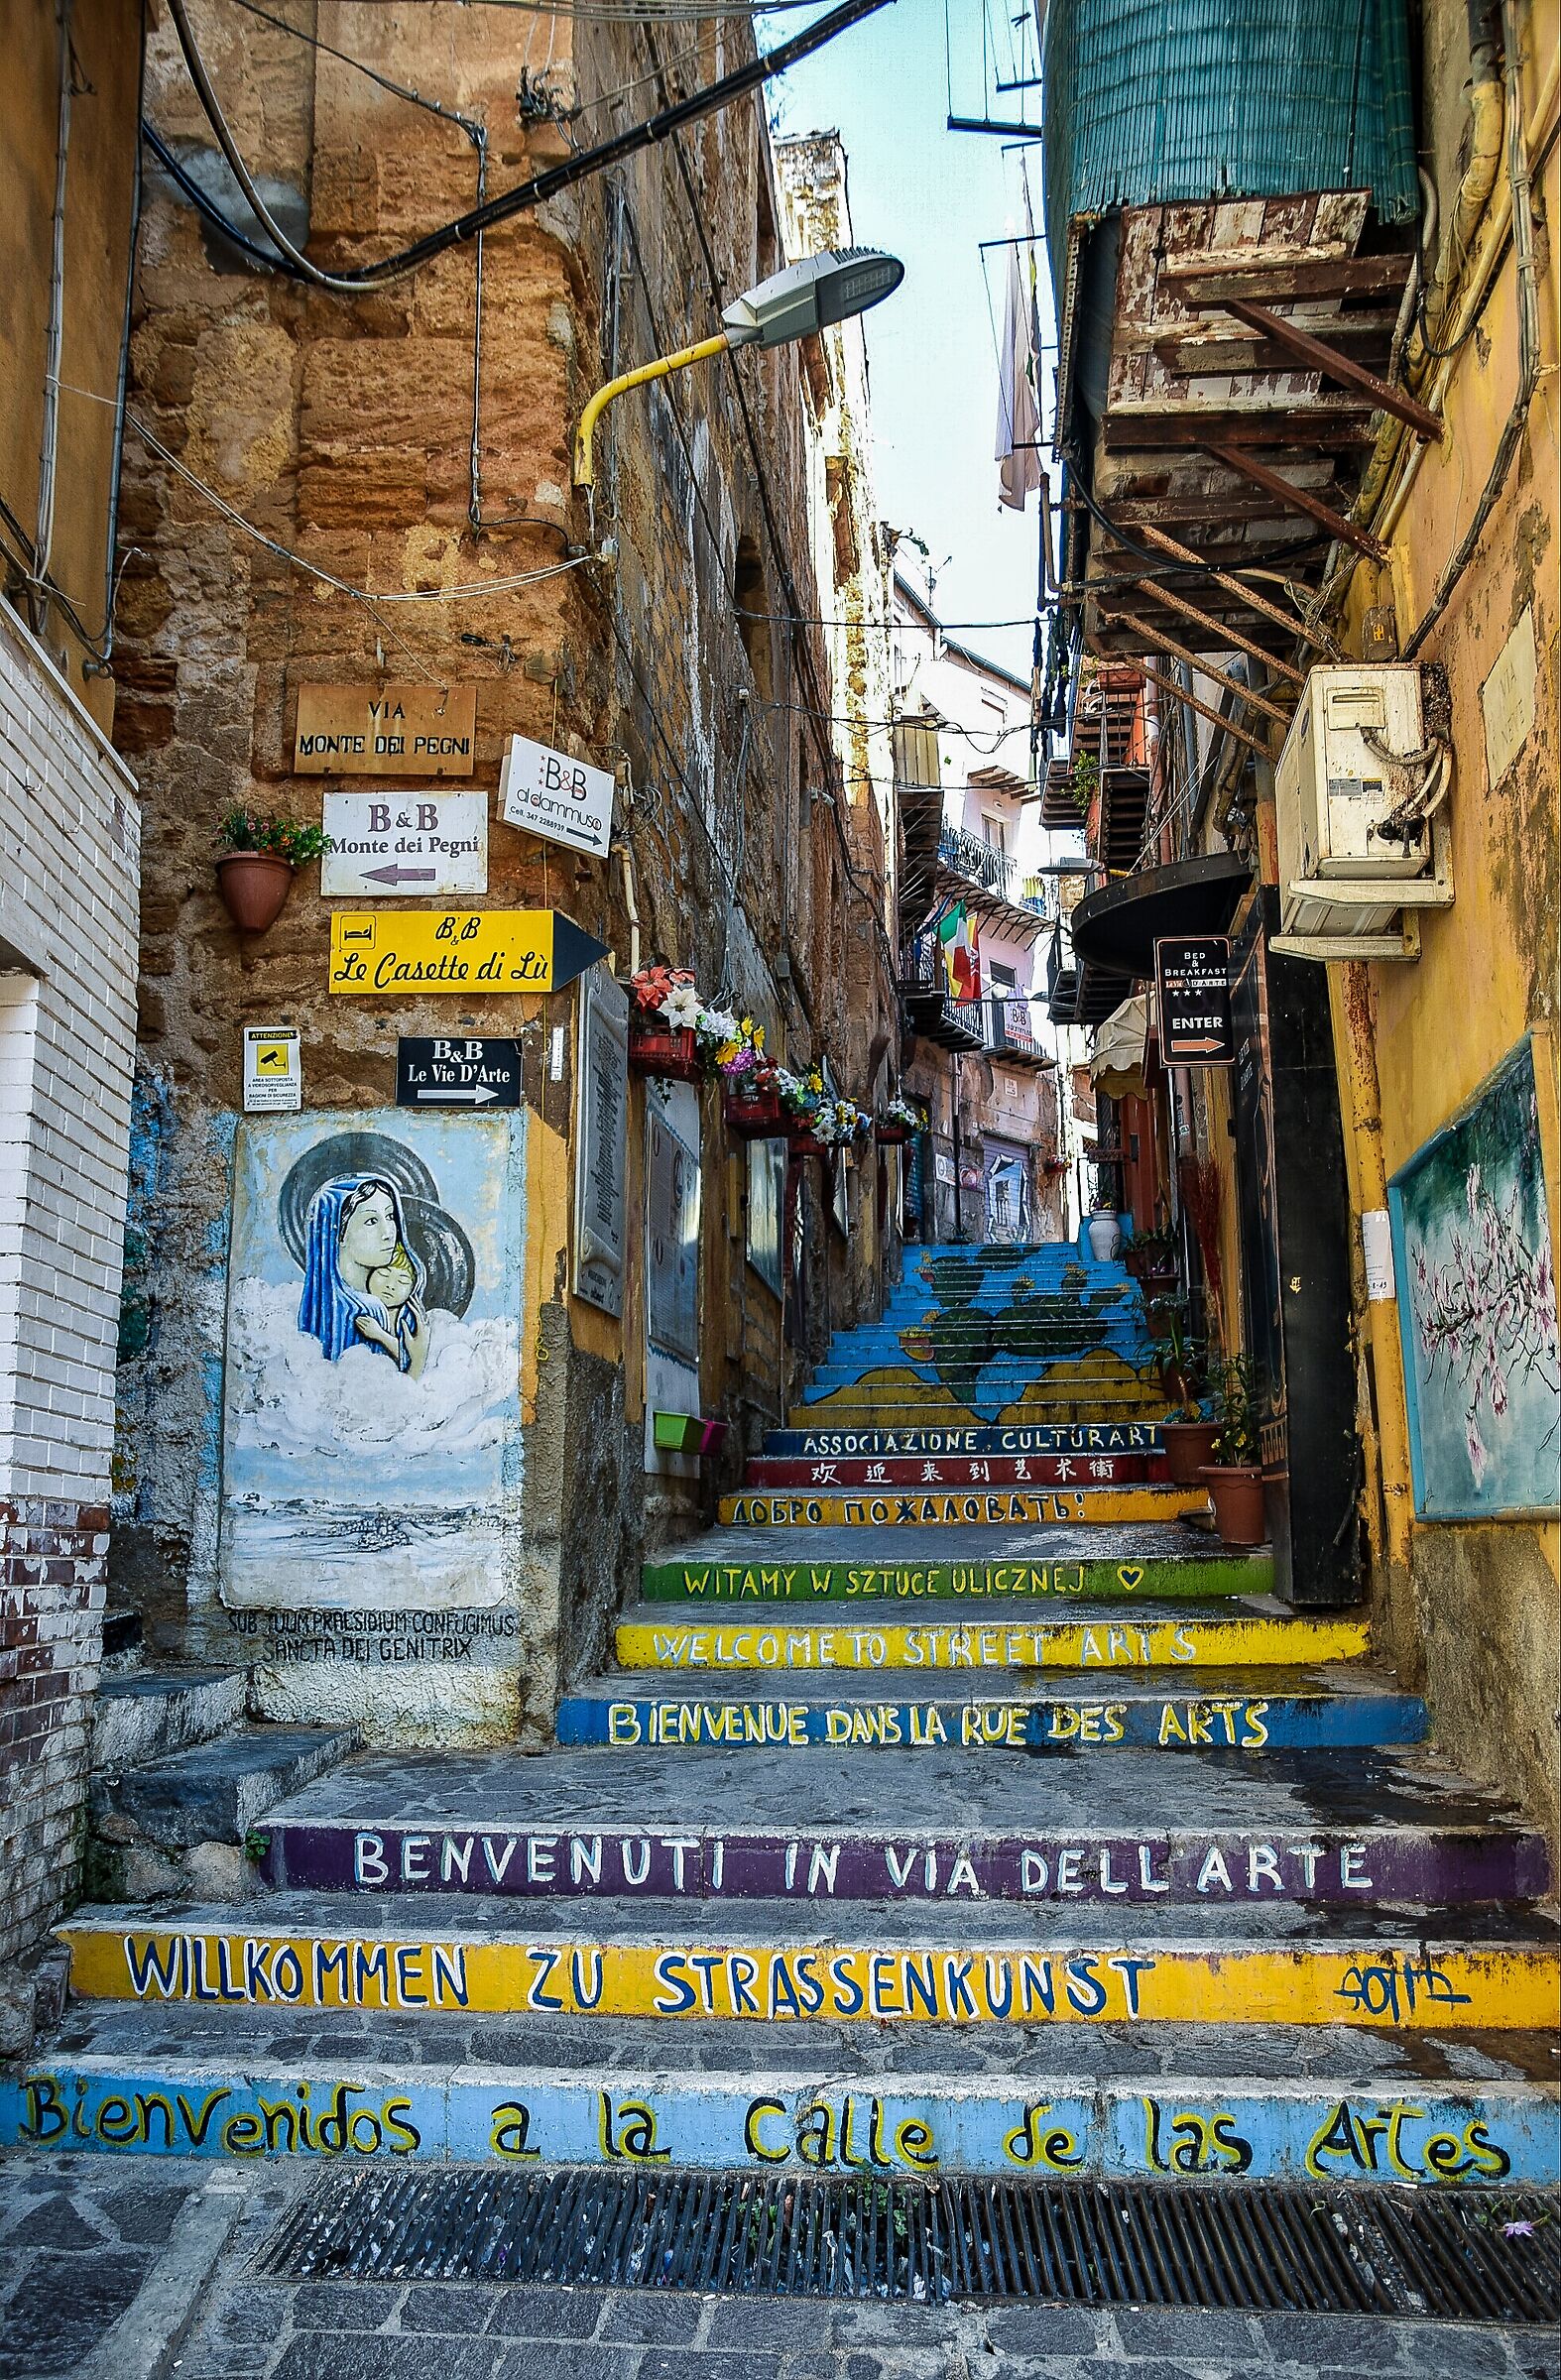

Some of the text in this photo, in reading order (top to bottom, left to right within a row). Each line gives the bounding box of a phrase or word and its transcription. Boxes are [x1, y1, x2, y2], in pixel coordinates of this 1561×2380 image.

[369, 701, 406, 719] VIA
[300, 735, 470, 756] MONTE DEI PEGNI
[545, 757, 587, 801] B&B
[526, 812, 539, 822] 347
[539, 816, 565, 832] 2288939
[329, 836, 479, 858] Monte dei Pegni
[435, 916, 481, 945] B&B
[333, 951, 548, 989] Le Casette di Lù
[1172, 1016, 1223, 1029] ENTER
[432, 1040, 483, 1063] B&B
[408, 1064, 511, 1083] Le Vie D'Arte
[804, 1425, 1155, 1455] ASSOCIAZIONE CULTURART
[732, 1491, 1085, 1525] ДОБРО ПОЖАЛОВАТЬ!
[684, 1565, 1085, 1599] WITAMY W SZTUCE ULICZNEJ
[228, 1611, 515, 1637] SUB TUUM PRAESIDIUM CONFUGIMUS
[259, 1637, 472, 1663] SANCTA DEI GENITRIX
[653, 1631, 835, 1666] WELCOME
[852, 1632, 887, 1665] TO
[903, 1630, 1053, 1666] STREET
[825, 1705, 901, 1745] DANS
[909, 1705, 948, 1745] LA
[961, 1706, 1029, 1746] RUE
[1047, 1703, 1128, 1743] DES
[1157, 1701, 1270, 1748] ARTS
[353, 1832, 726, 1891] BENVENUTI
[783, 1842, 841, 1893] IN
[1020, 1844, 1171, 1894] DELL
[1195, 1843, 1375, 1894] ARTE
[124, 1934, 1155, 2021] WILLKOMMEN ZU STRASSENKUNST
[18, 2074, 1511, 2182] Bienvenidos a la Calle de las Artes
